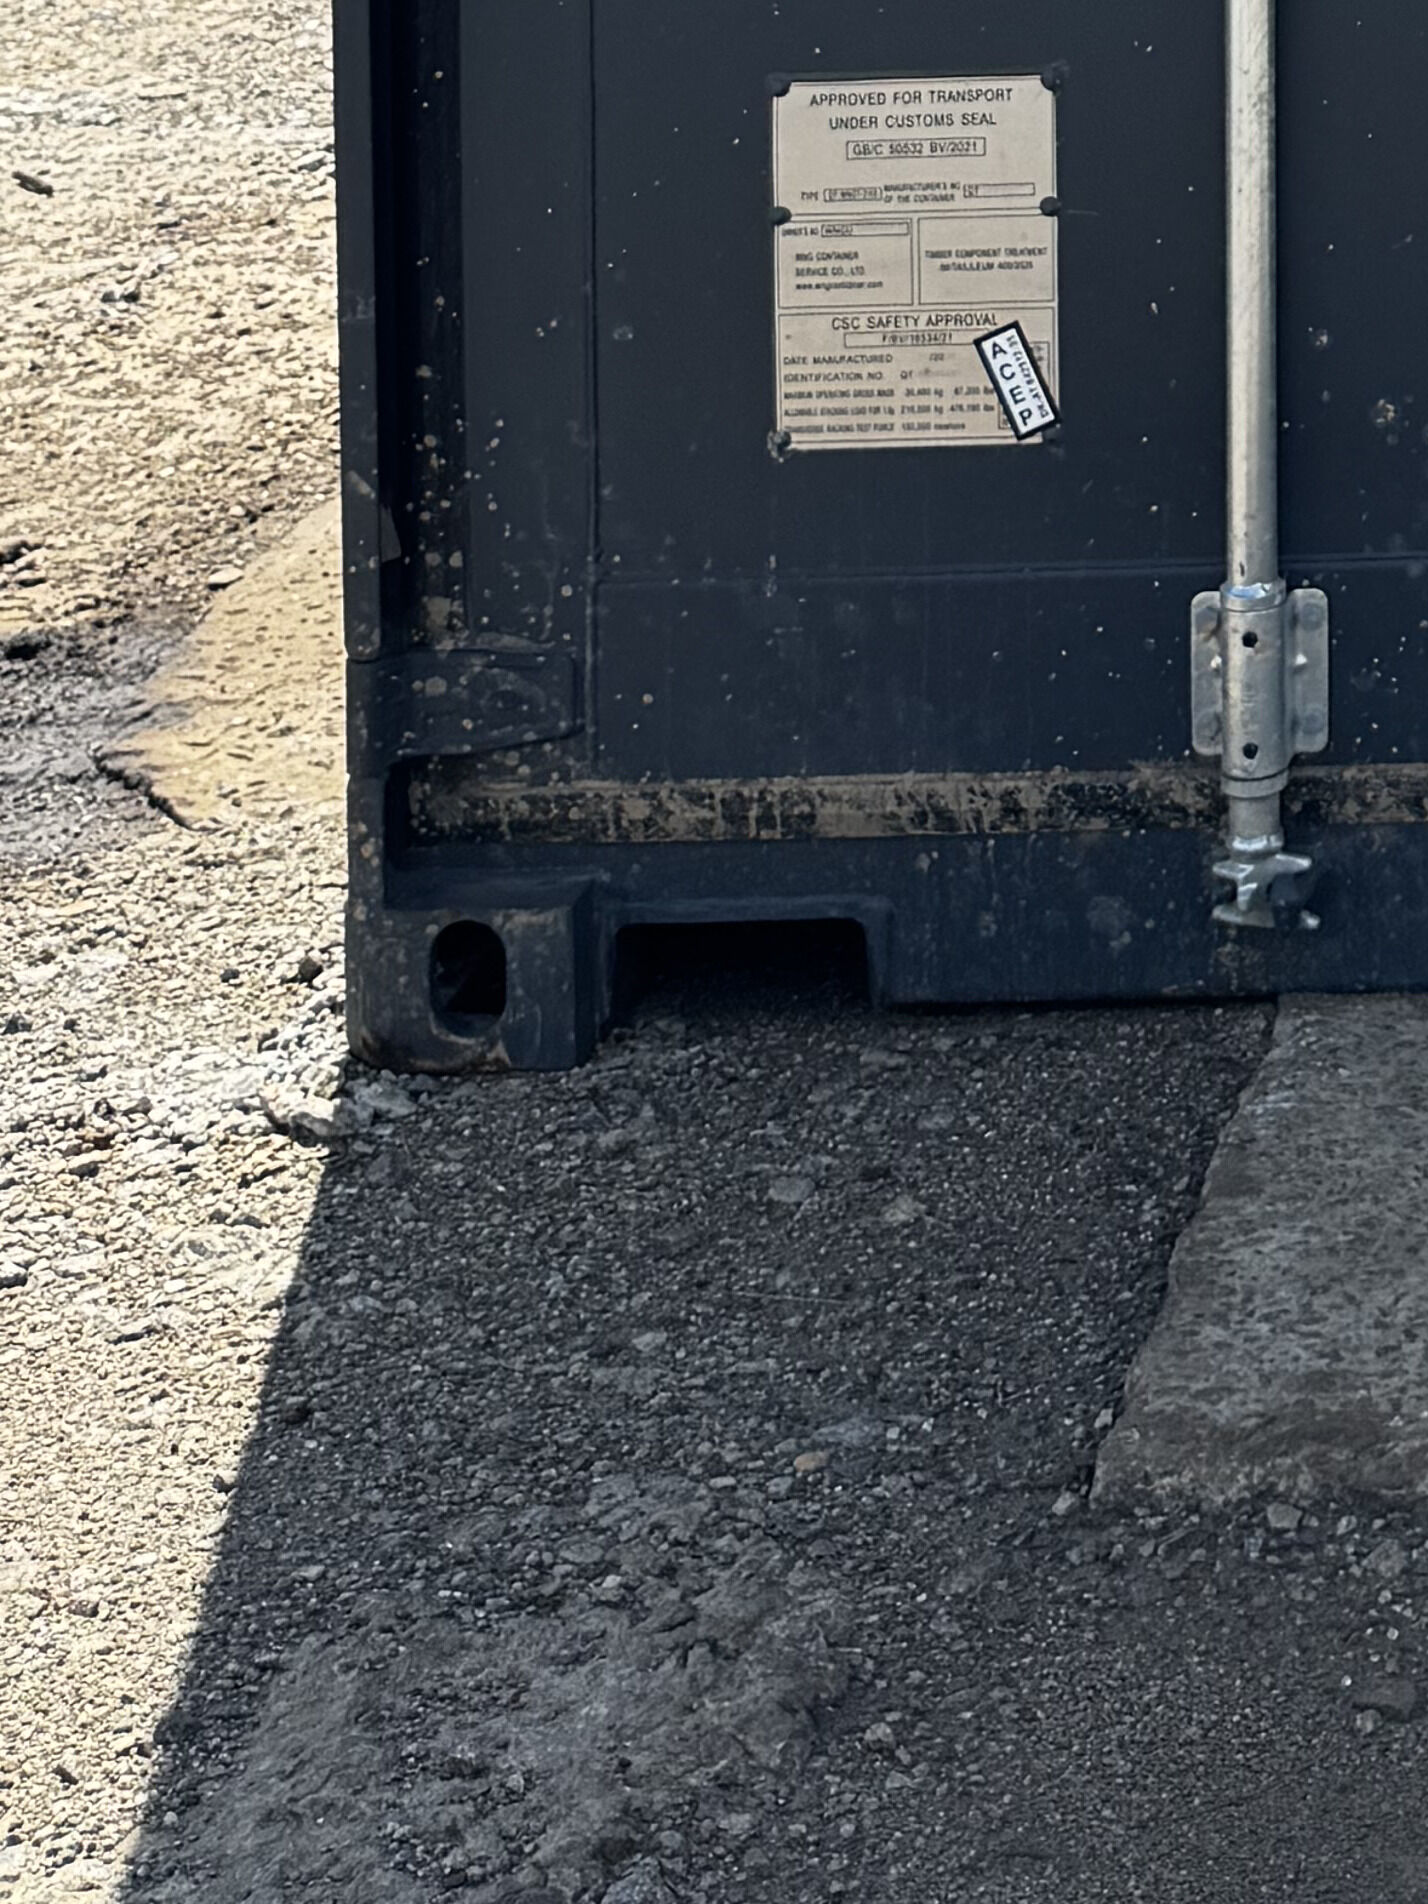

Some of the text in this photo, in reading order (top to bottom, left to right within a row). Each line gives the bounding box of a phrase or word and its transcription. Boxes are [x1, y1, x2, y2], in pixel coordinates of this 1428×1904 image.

[810, 88, 1013, 107] APPROVED FOR TRANSPORT
[829, 112, 997, 130] UNDER CUSTOMS SEAL
[832, 313, 998, 330] CSC SAFETY APPROVAL
